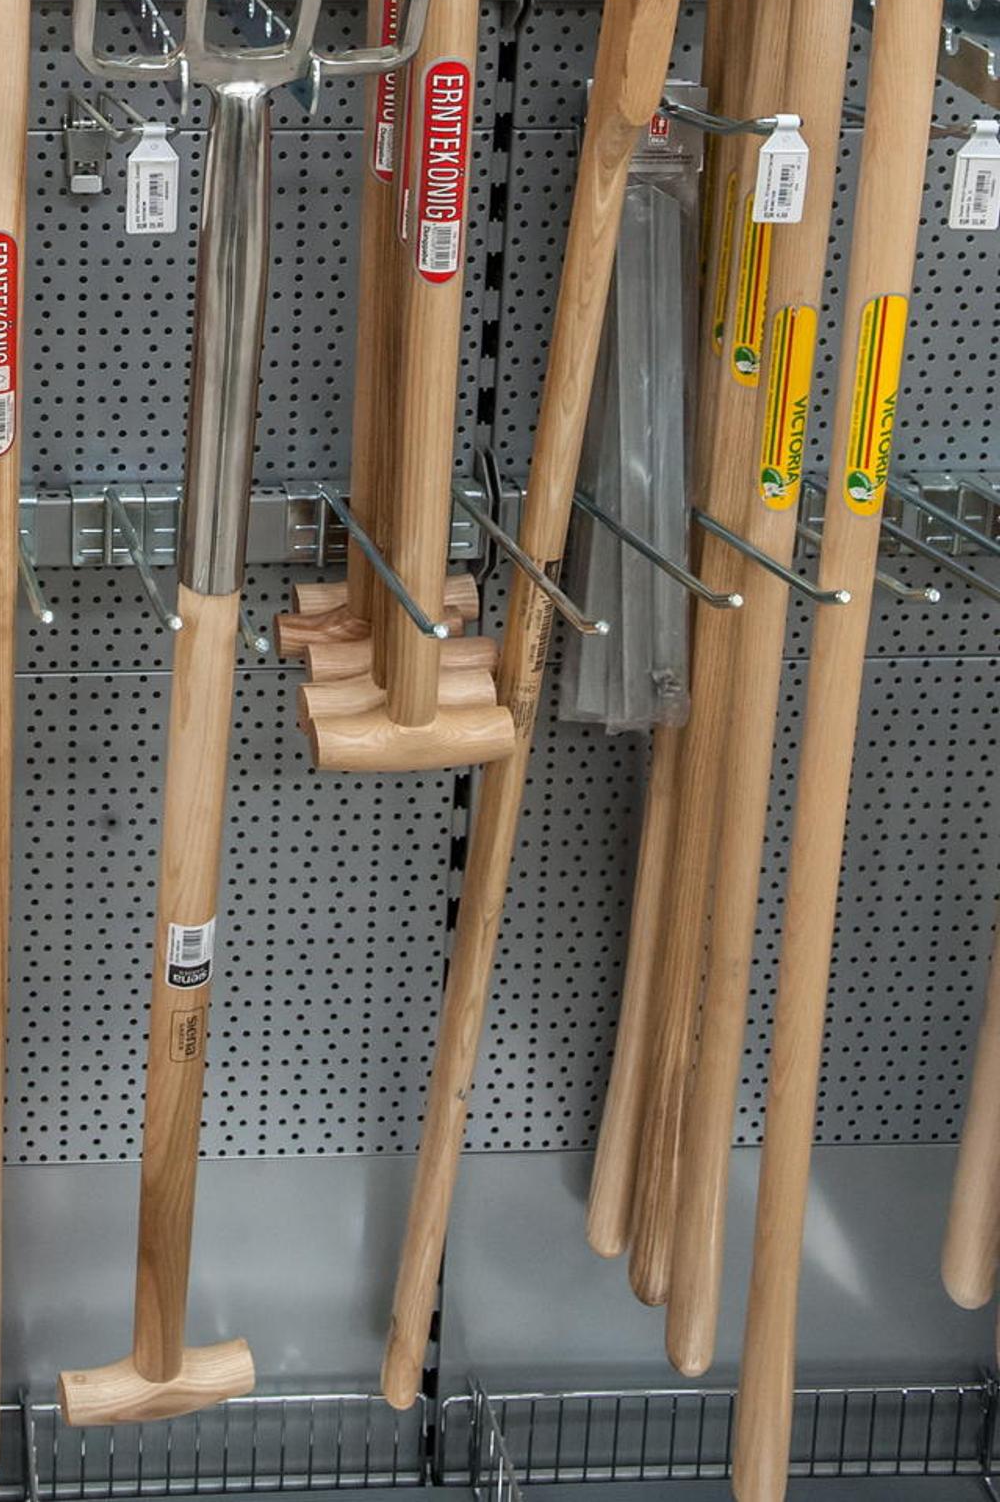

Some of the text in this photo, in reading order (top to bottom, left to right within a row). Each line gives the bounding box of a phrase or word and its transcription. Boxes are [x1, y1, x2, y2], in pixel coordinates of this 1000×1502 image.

[424, 73, 465, 220] ERNTEKÖNIG
[420, 225, 431, 267] Dunggabel
[786, 395, 809, 487] VICTORIA
[875, 390, 898, 487] VICTORIA
[172, 971, 208, 985] siena
[184, 1014, 198, 1057] siena
